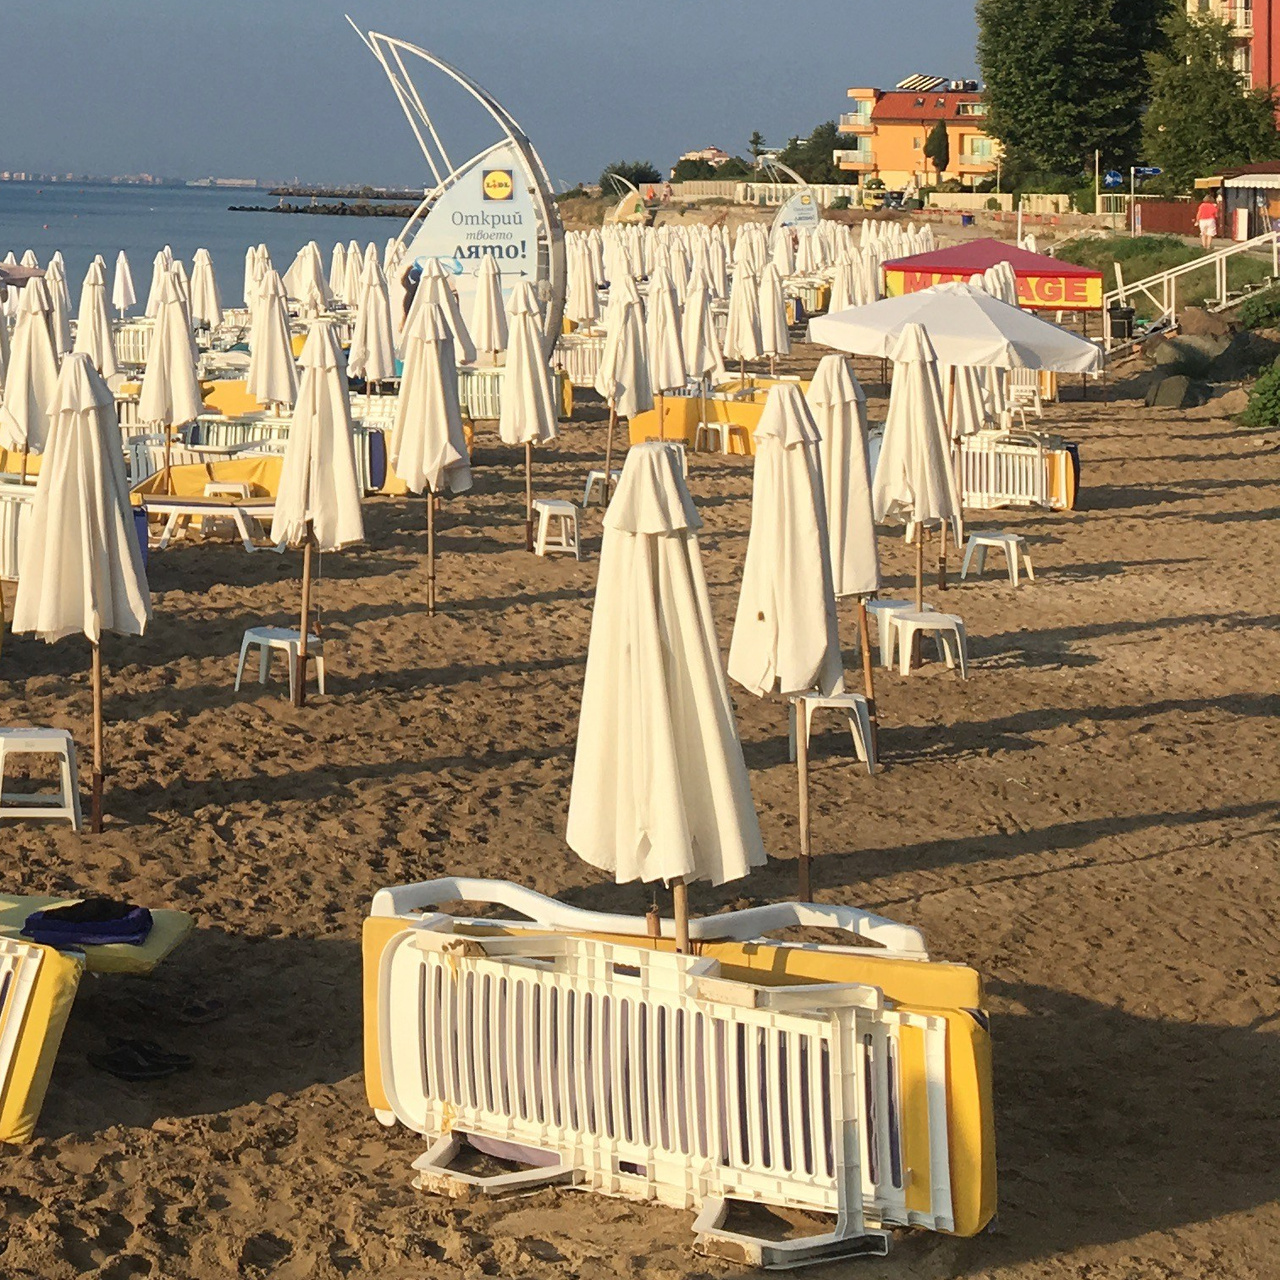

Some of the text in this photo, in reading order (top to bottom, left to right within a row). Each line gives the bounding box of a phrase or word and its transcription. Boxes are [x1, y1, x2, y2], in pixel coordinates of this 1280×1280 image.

[451, 210, 522, 228] Открий
[465, 230, 513, 240] твоето
[452, 240, 526, 259] лято!
